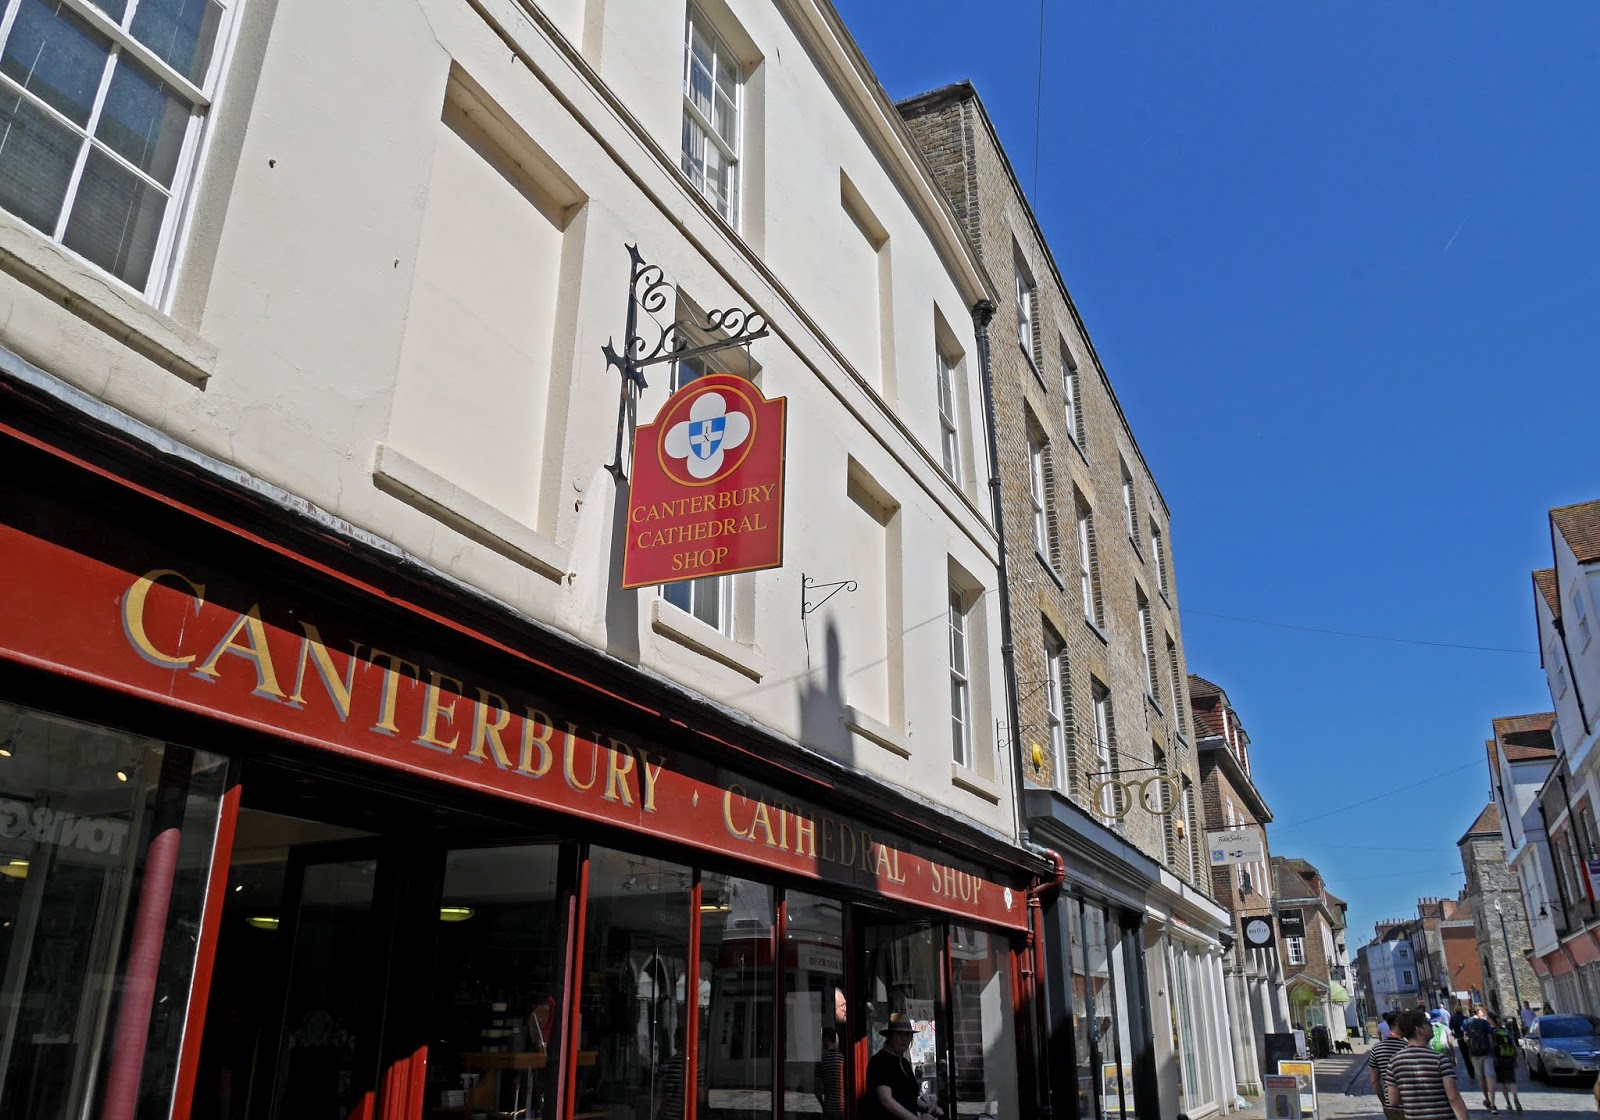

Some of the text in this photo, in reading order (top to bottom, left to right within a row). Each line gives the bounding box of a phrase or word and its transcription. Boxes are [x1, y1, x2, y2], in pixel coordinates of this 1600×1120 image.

[632, 484, 775, 523] CANTERBURY
[637, 513, 768, 549] CATHEDRAL
[672, 546, 729, 571] SHOP
[122, 568, 982, 904] CANTERBURY CATHEDRAL SHOP
